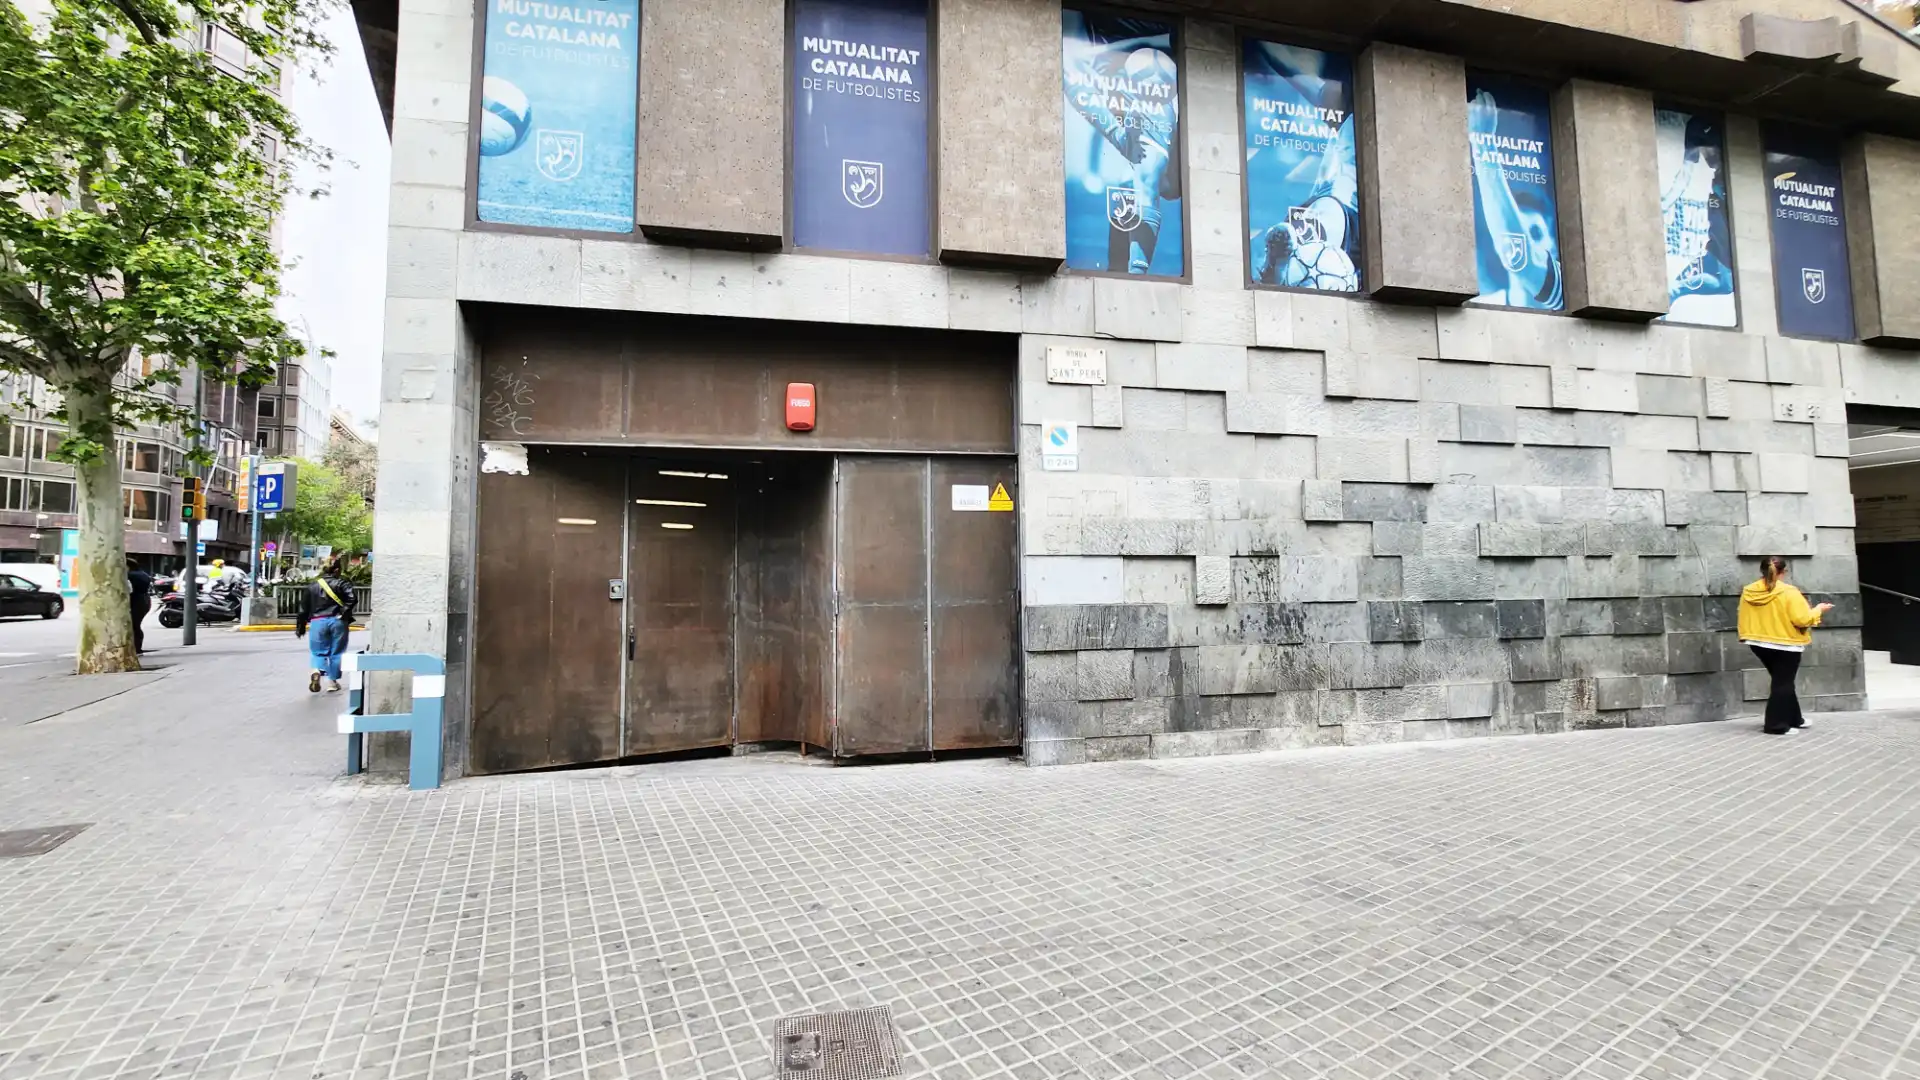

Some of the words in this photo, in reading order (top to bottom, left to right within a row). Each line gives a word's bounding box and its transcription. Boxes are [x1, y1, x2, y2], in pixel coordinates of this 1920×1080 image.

[496, 0, 632, 29] MUTUALITAT
[504, 21, 621, 50] CATALANA
[494, 41, 518, 56] DE
[522, 44, 629, 69] FUTBOLISTES
[803, 36, 920, 65] MUTUALITAT
[810, 58, 913, 85] CATALANA
[802, 77, 823, 91] DE
[827, 80, 921, 103] FUTBOLISTES
[1075, 92, 1166, 117] CATALANA
[1253, 97, 1344, 123] MUTUALITAT
[1260, 116, 1340, 141] CATALANA
[1254, 134, 1270, 146] DE
[1273, 136, 1329, 154] FUTBOLIS
[1474, 150, 1541, 170] CATALANA
[1773, 177, 1836, 198] MUTUALITAT
[1779, 194, 1834, 213] CATALANA
[1775, 208, 1787, 219] DE
[1788, 210, 1839, 226] FUTBOLISTES
[1052, 368, 1075, 379] SANT
[791, 398, 811, 408] FUEGO
[265, 477, 277, 499] P
